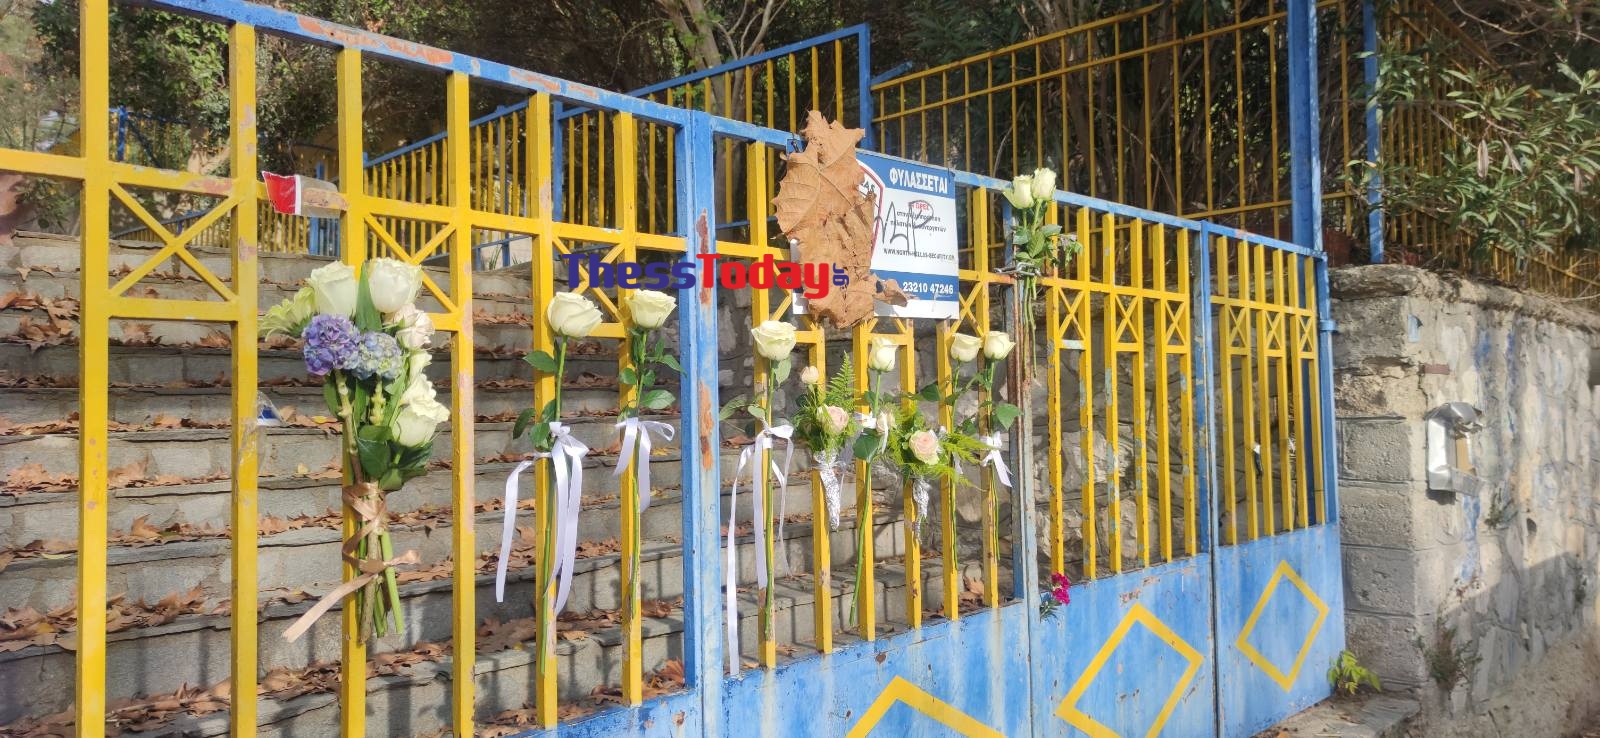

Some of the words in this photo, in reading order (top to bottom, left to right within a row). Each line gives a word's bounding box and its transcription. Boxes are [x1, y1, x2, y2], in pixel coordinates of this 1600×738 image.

[890, 168, 948, 194] ΦΥΛΑΣΣΕΤΑΙ
[902, 281, 928, 293] 23210
[929, 283, 954, 295] 47246
